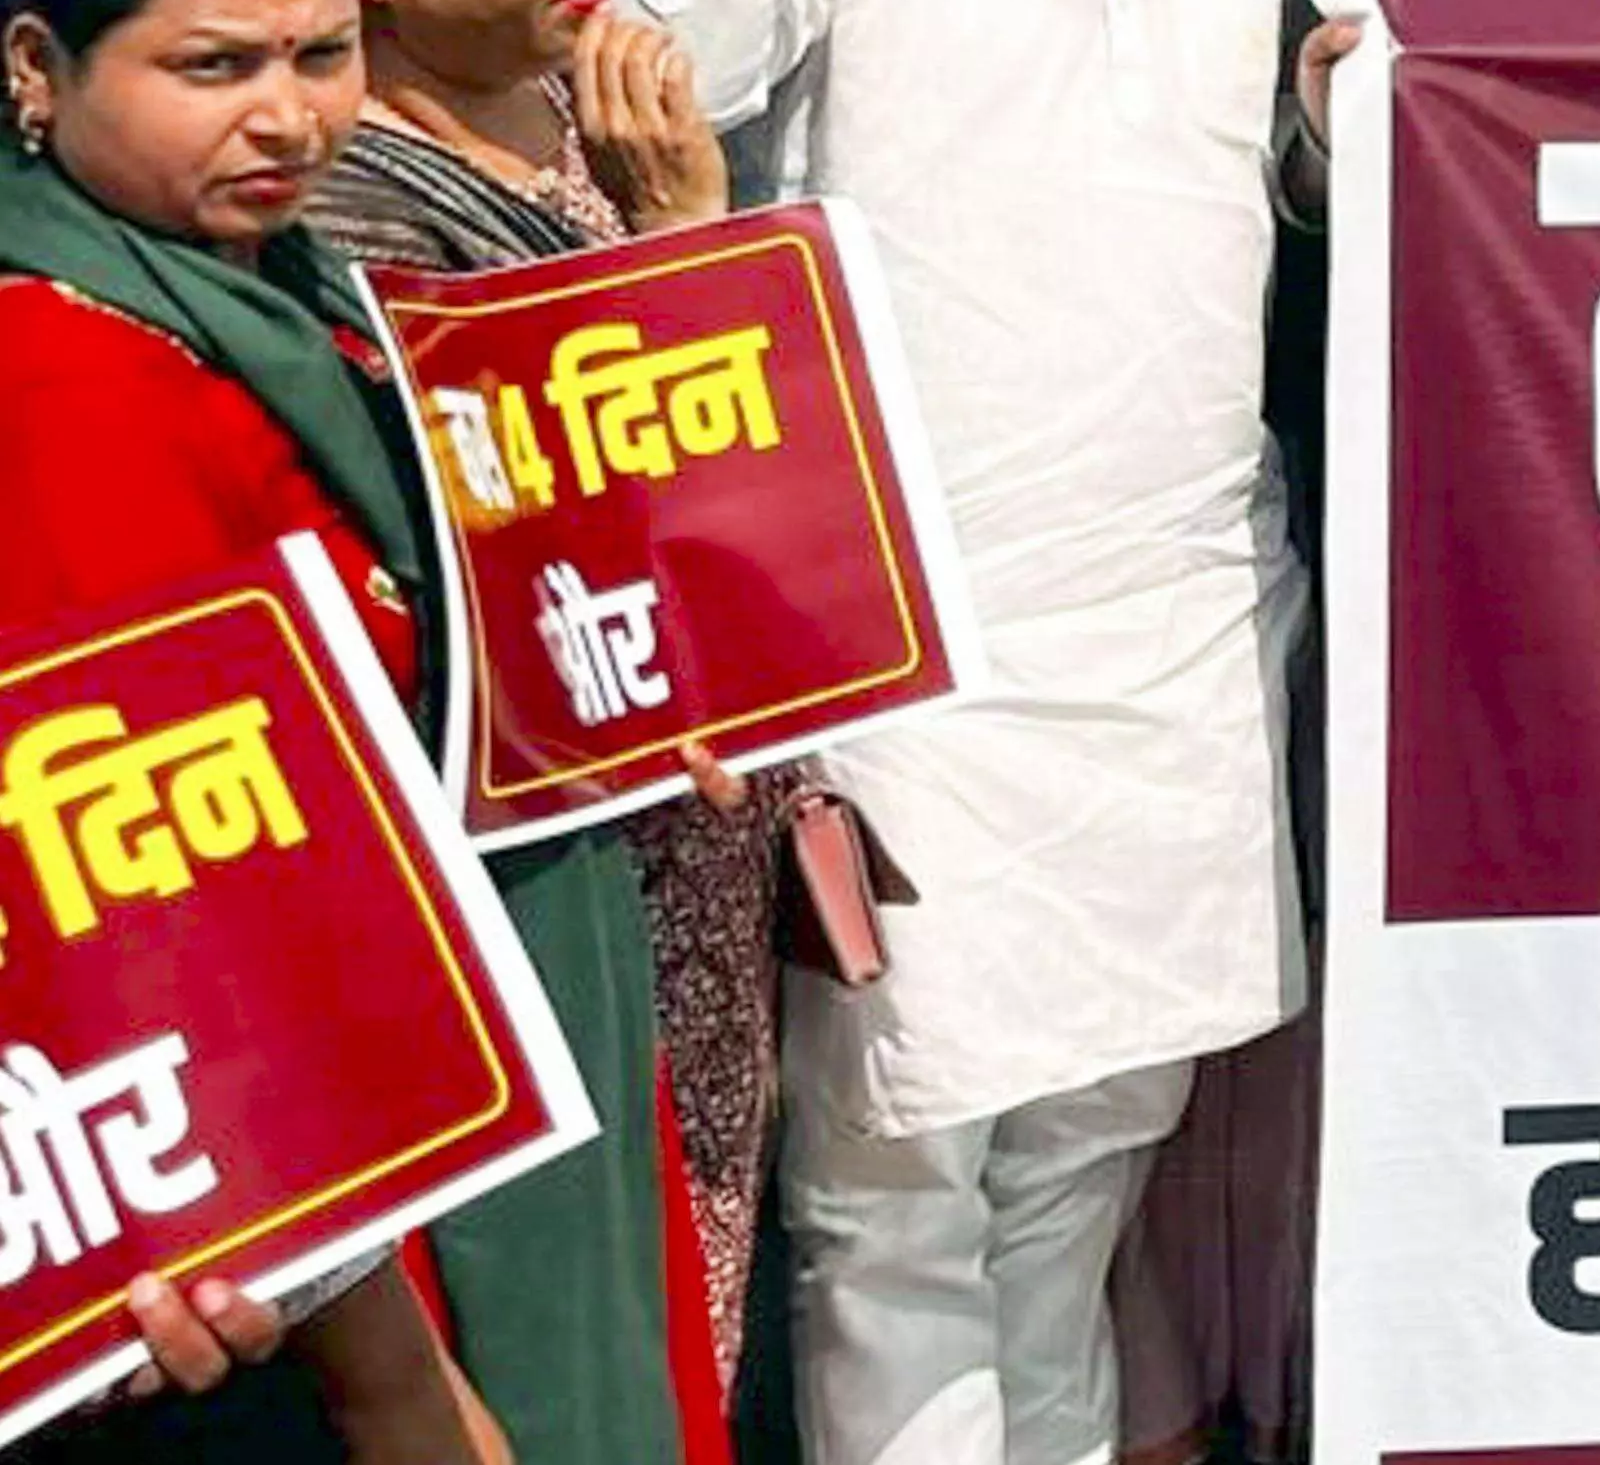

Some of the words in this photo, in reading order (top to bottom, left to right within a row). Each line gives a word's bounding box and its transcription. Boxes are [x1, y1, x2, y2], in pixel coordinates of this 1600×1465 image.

[499, 383, 555, 509] 4
[543, 323, 781, 498] दिन
[0, 699, 306, 938] दिन
